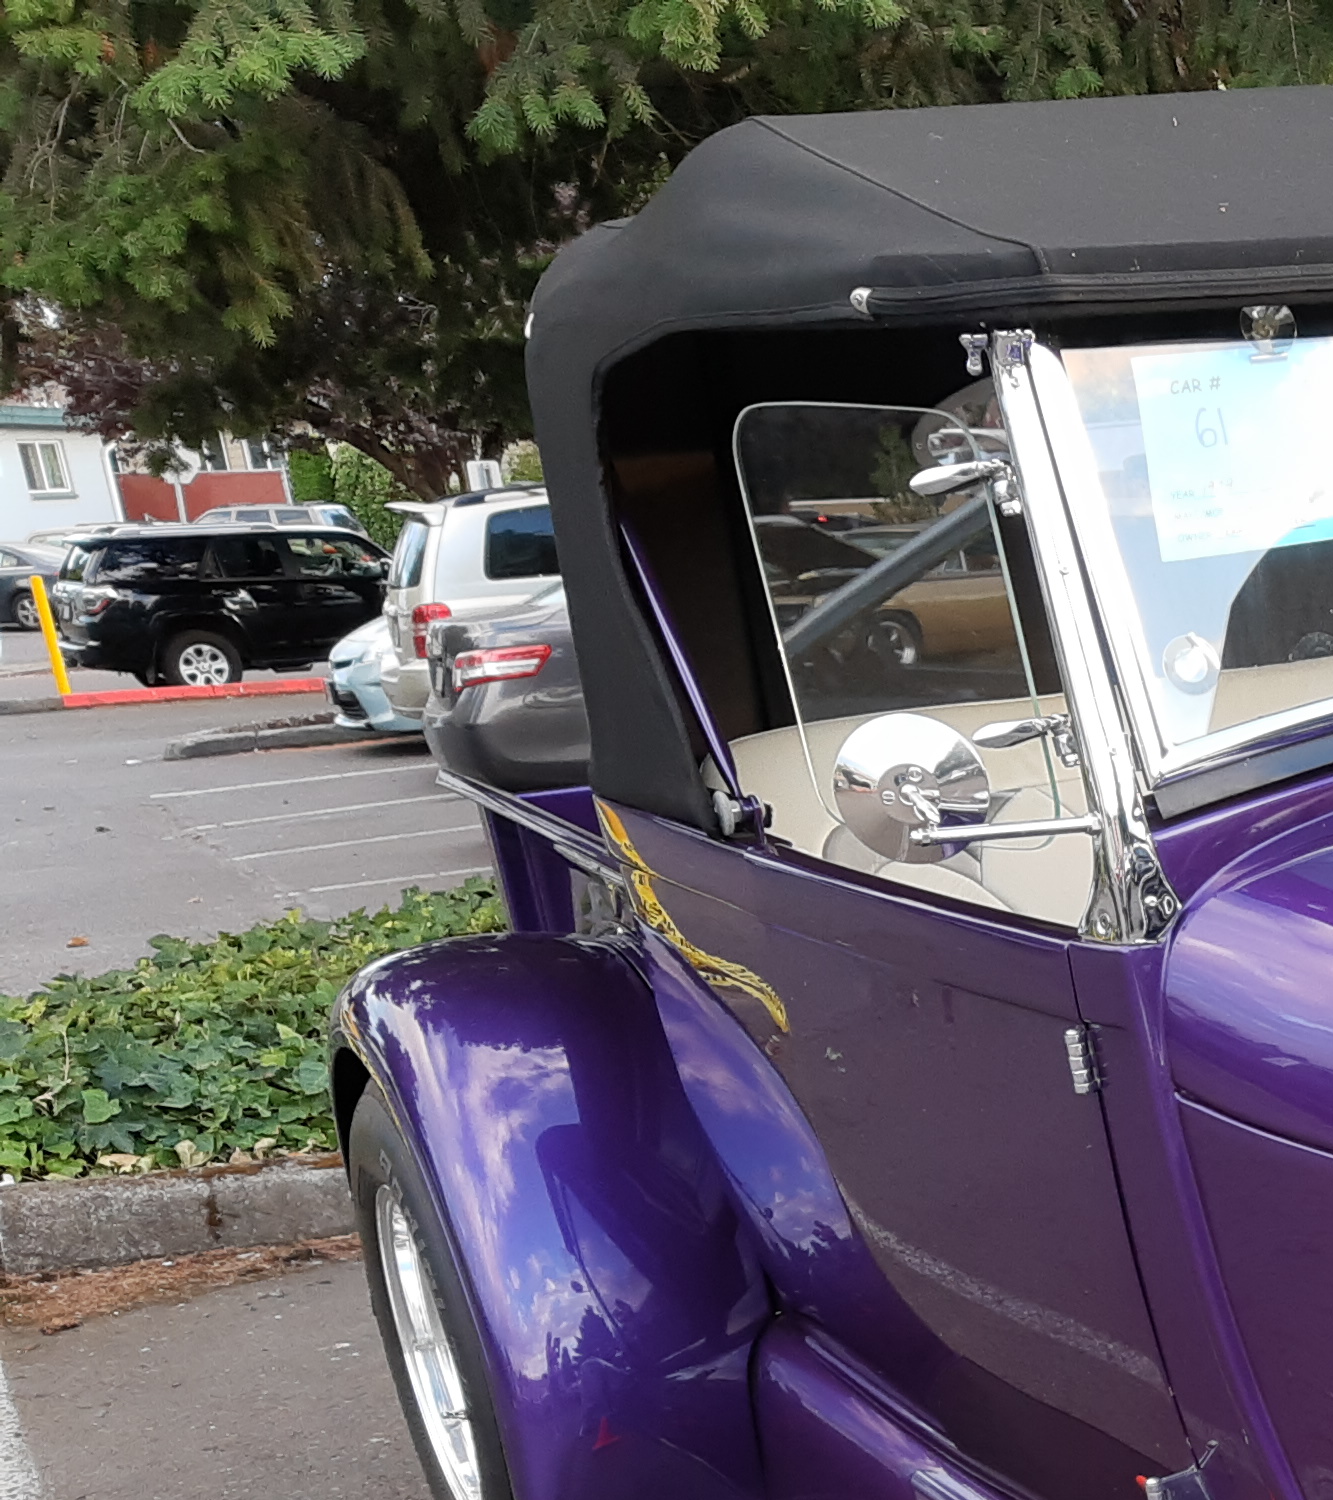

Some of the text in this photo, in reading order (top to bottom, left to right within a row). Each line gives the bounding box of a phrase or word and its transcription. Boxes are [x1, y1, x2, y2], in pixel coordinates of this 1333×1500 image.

[1170, 375, 1221, 394] CAR #
[1195, 406, 1229, 448] 61
